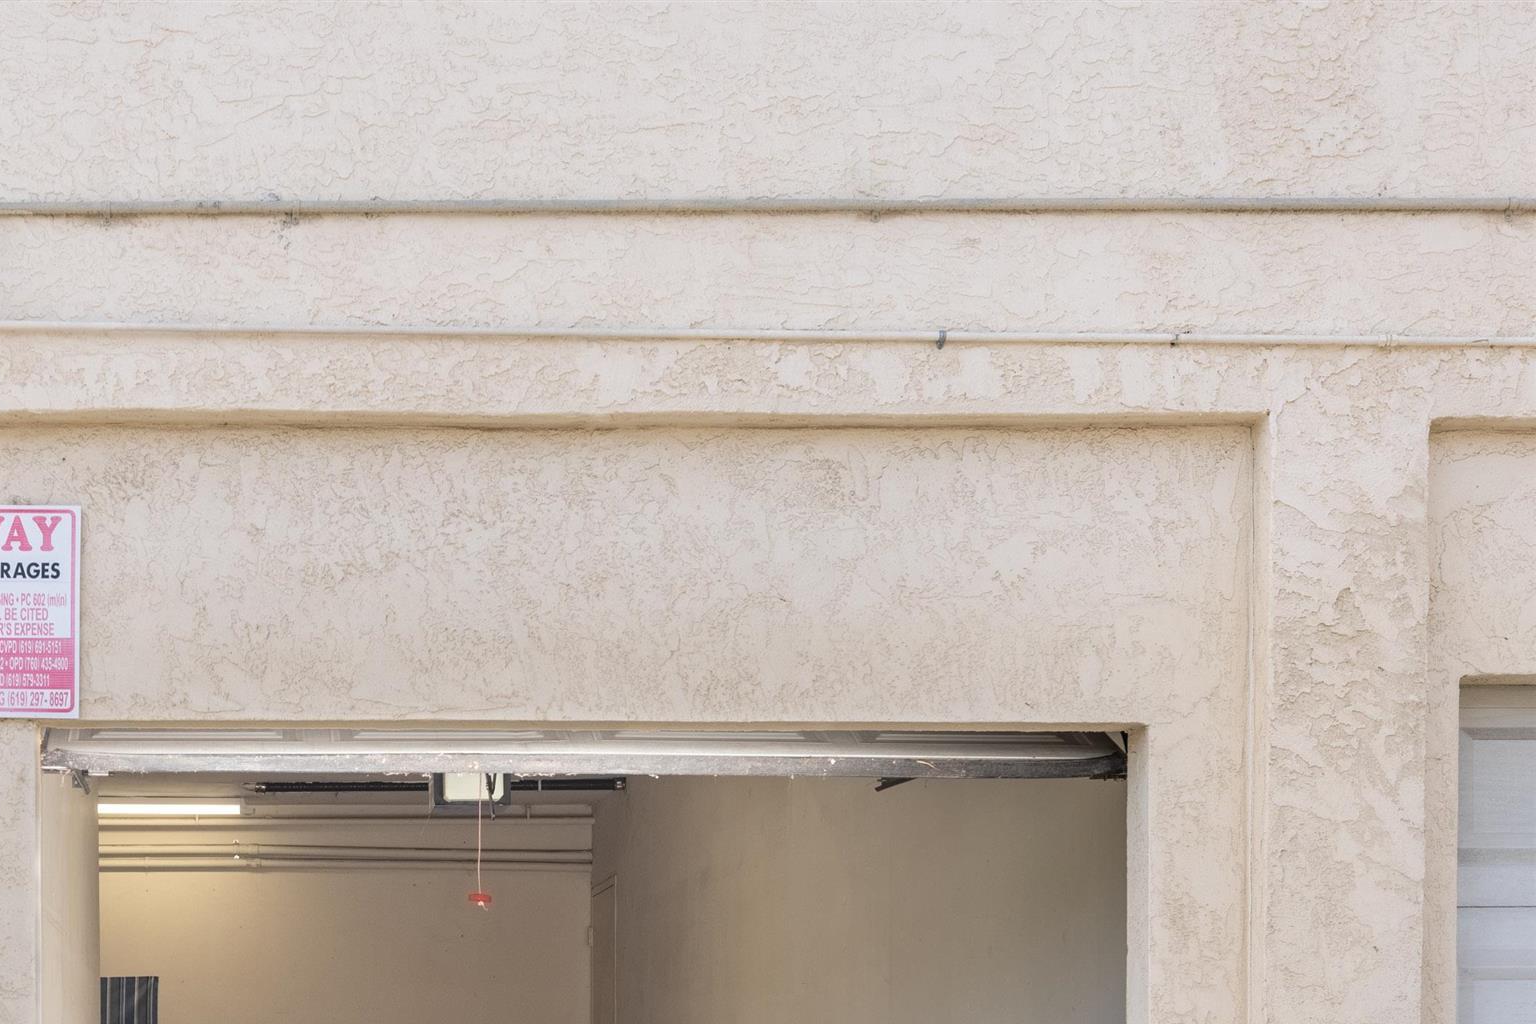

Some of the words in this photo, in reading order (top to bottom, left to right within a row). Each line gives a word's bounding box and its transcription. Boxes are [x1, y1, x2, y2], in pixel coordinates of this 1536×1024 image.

[20, 593, 31, 606] PC
[4, 608, 17, 621] BE
[19, 608, 49, 621] CITED
[14, 622, 55, 635] EXPENSE
[9, 657, 24, 670] OPD
[7, 691, 27, 707] (619)
